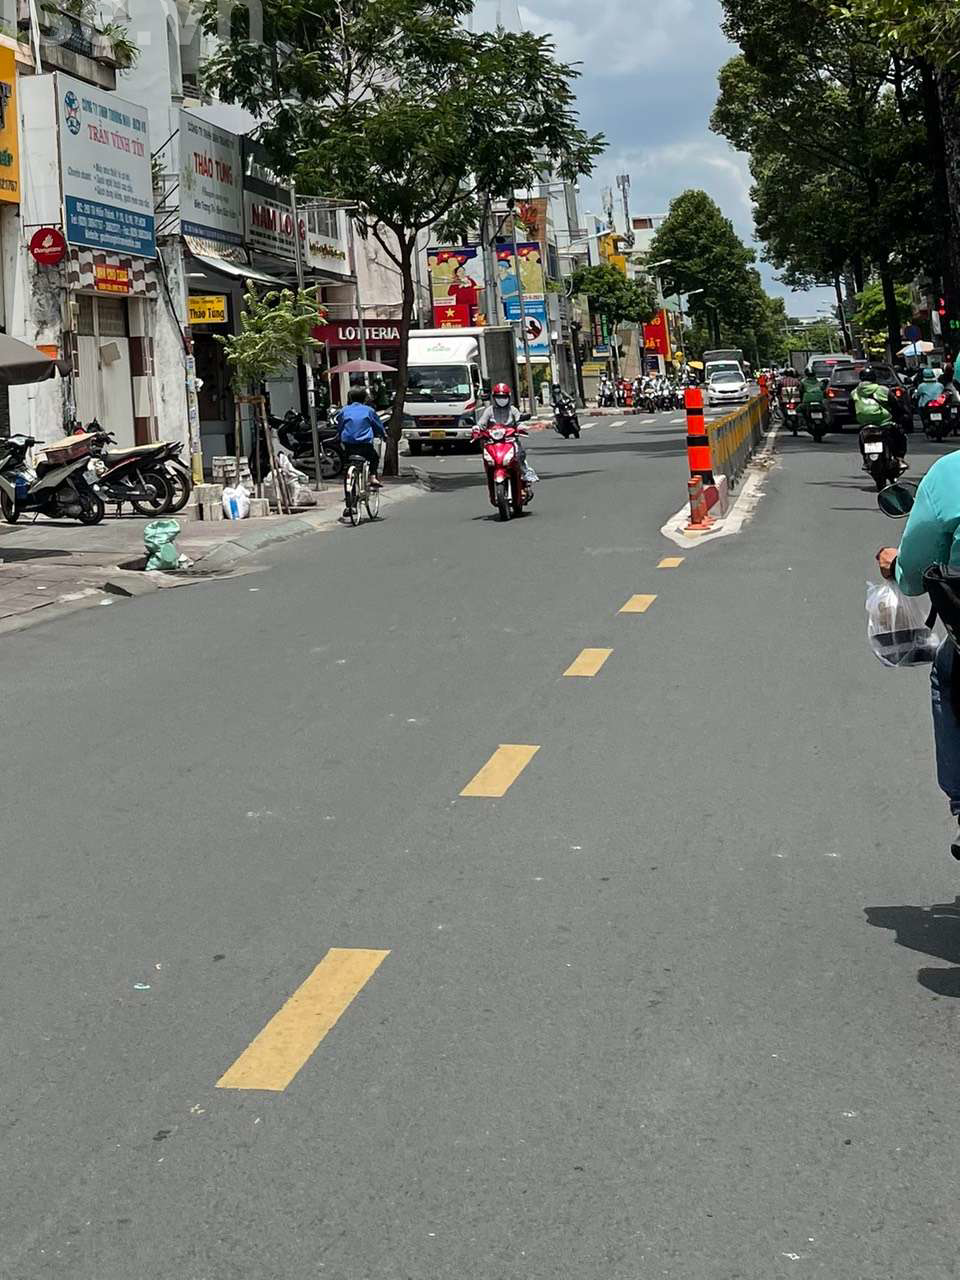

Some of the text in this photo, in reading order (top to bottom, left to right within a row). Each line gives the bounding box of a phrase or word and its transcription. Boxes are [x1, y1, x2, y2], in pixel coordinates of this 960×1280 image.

[193, 150, 214, 179] THẢO
[190, 307, 206, 320] Thảo
[337, 326, 401, 341] LOTTERIA
